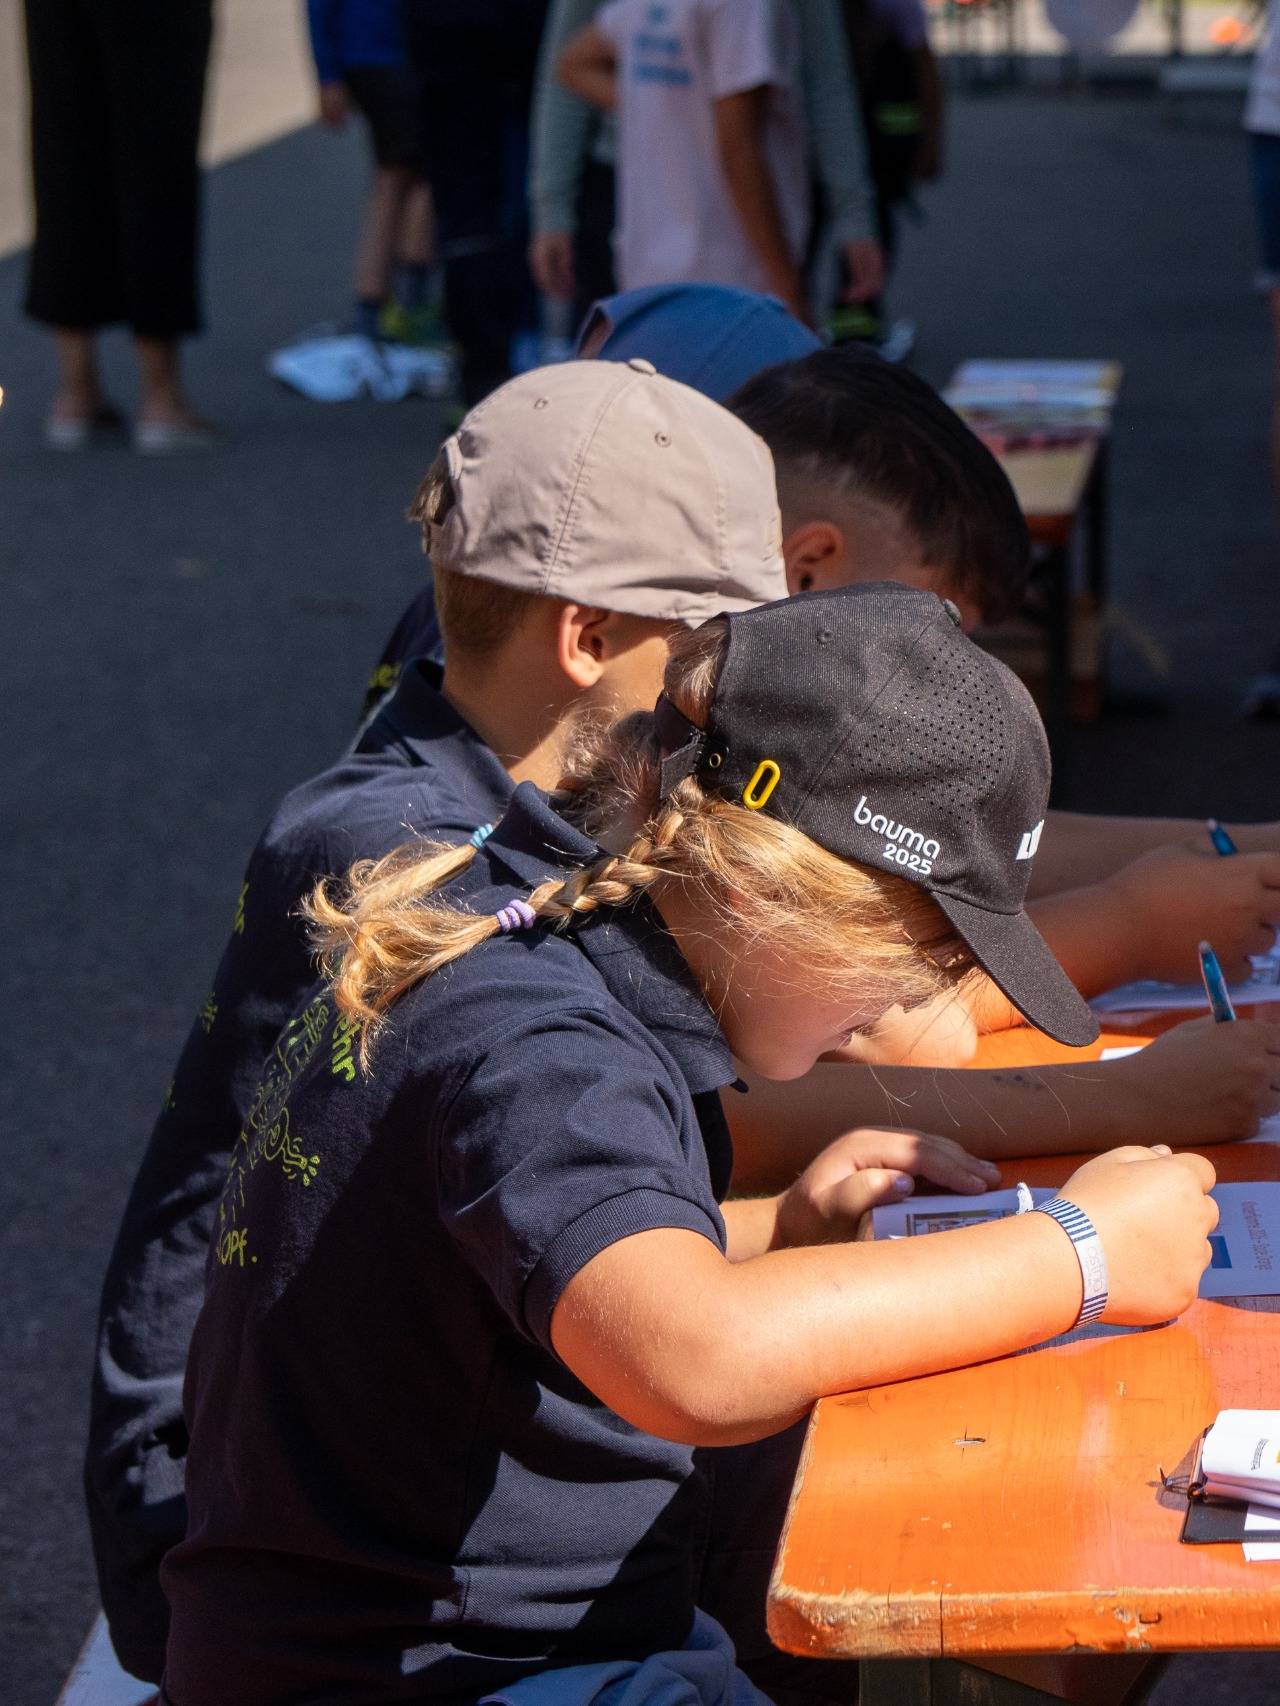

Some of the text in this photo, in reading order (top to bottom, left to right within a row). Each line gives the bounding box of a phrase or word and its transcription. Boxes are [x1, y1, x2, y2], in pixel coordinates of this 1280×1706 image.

[853, 795, 940, 860] bauma
[882, 843, 933, 875] 2025
[332, 1009, 361, 1082] ehr
